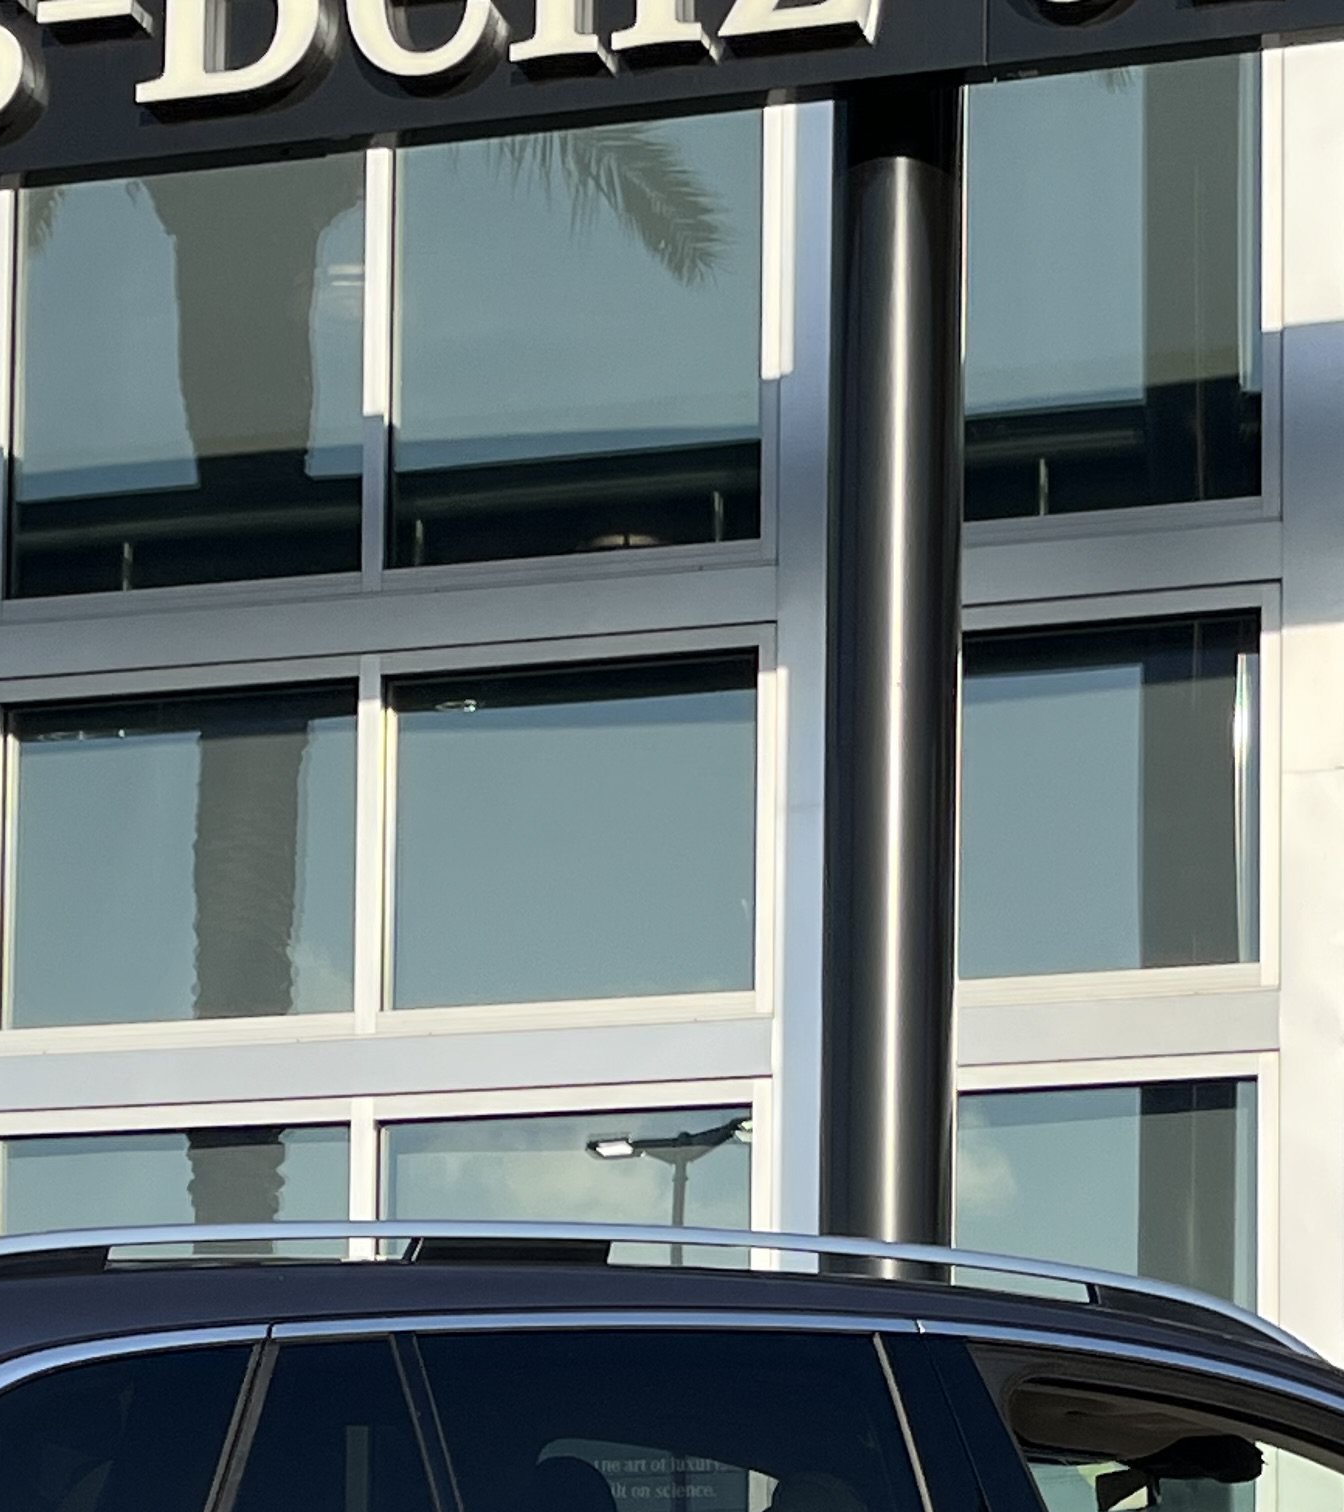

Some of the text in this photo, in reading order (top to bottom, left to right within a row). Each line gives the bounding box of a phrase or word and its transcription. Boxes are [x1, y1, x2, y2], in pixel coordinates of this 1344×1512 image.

[624, 1458, 646, 1472] art
[631, 1486, 650, 1498] on
[655, 1481, 717, 1498] science.
